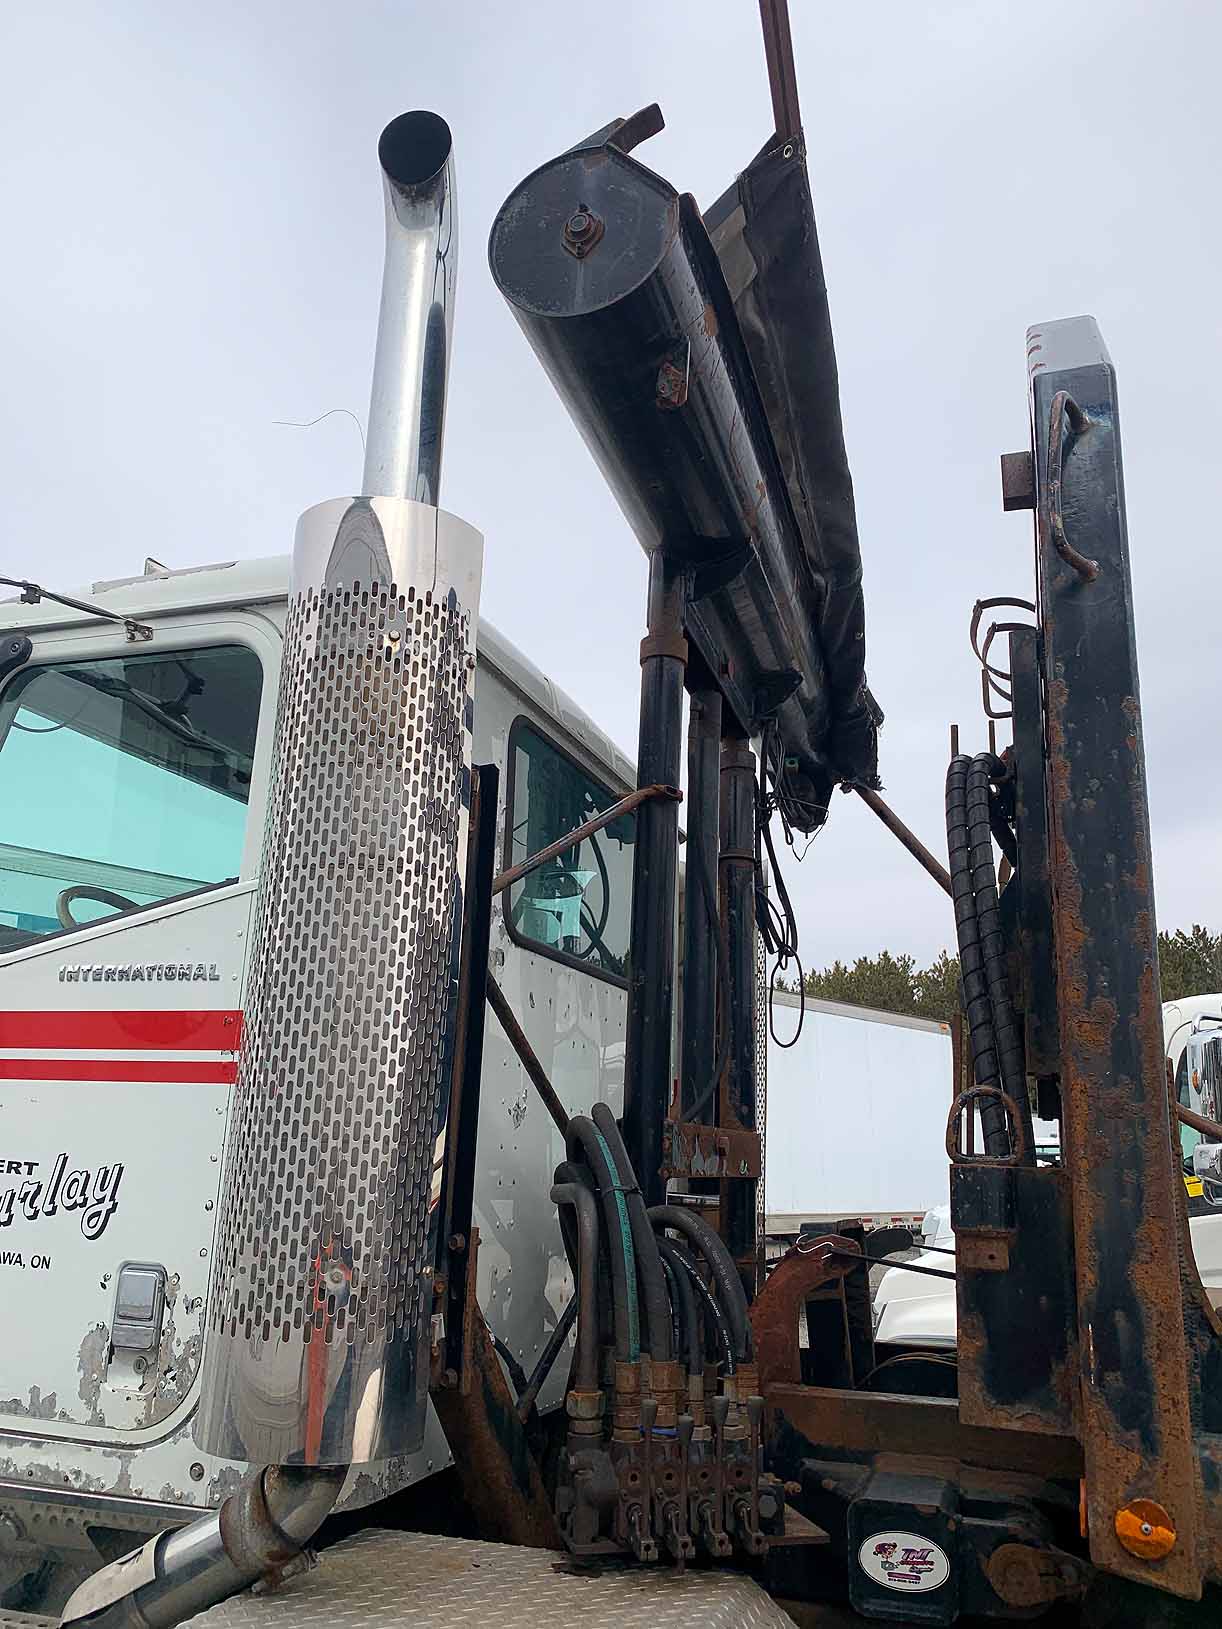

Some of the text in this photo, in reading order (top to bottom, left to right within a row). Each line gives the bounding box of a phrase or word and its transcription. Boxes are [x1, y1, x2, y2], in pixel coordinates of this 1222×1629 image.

[58, 963, 221, 983] INTERNATIONAL
[0, 1251, 51, 1270] WA, ON
